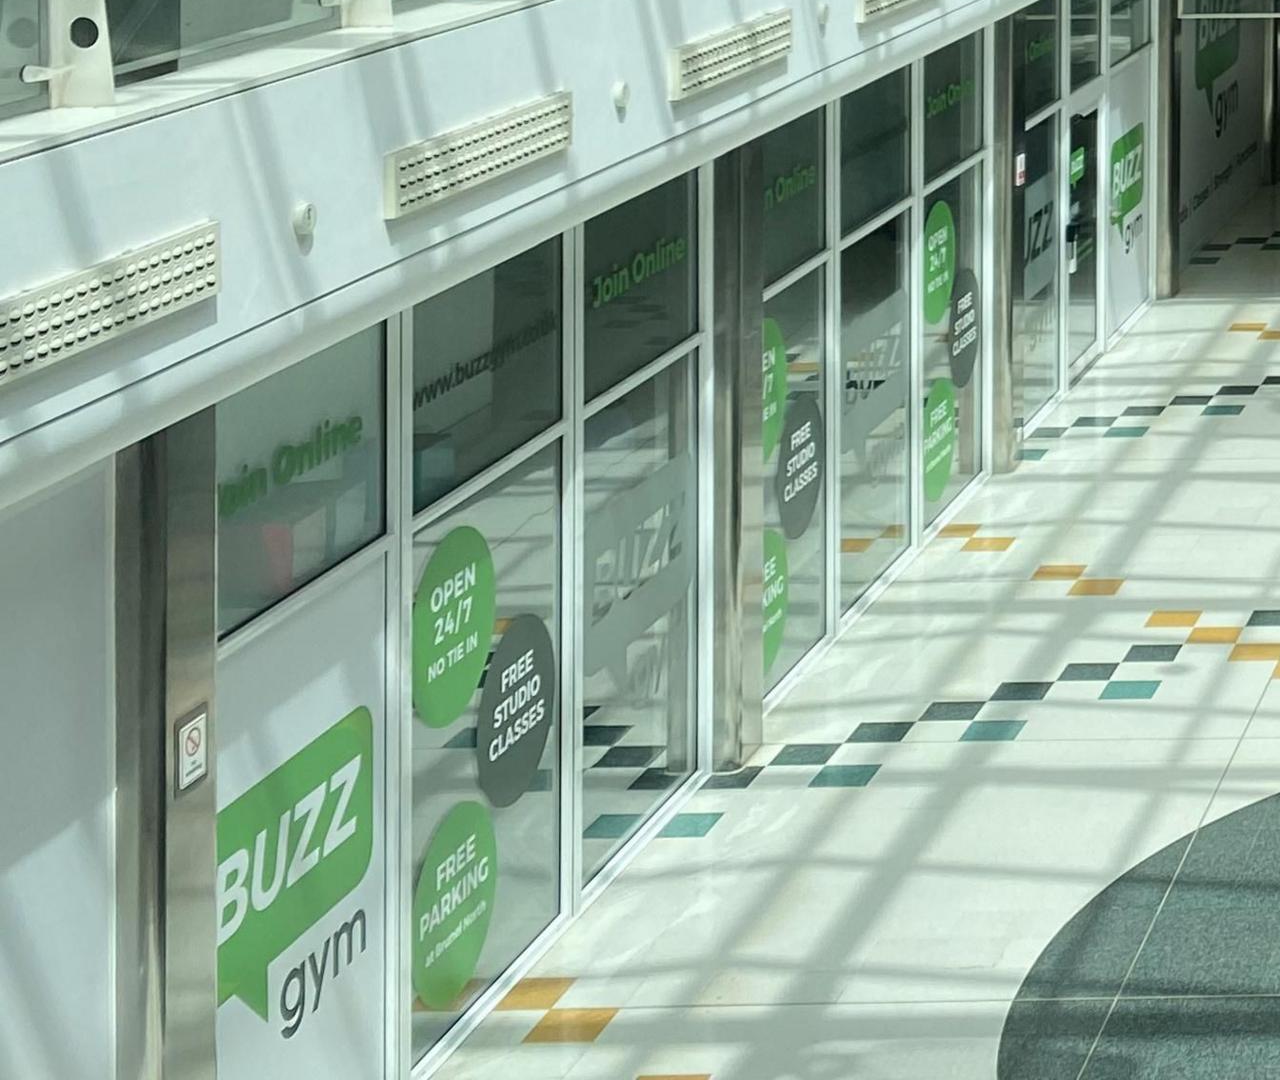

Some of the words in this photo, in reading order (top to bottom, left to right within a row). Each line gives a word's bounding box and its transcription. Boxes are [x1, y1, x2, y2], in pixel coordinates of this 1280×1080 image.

[1215, 80, 1239, 138] gym
[775, 164, 816, 203] Online
[1112, 143, 1142, 200] BUZZ
[1124, 213, 1144, 255] gym
[592, 263, 630, 309] Join
[632, 237, 687, 283] Online
[954, 309, 975, 336] STUDIO
[957, 291, 973, 315] FREE
[762, 347, 776, 373] EN
[952, 326, 977, 357] CLASSES
[791, 422, 811, 452] FREE
[930, 399, 948, 428] FREE
[272, 415, 363, 487] Online
[786, 441, 815, 478] STUDIO
[784, 461, 818, 503] CLASSES
[430, 562, 476, 613] OPEN
[763, 555, 777, 583] EE
[763, 575, 784, 608] KING
[434, 595, 473, 645] 24/7
[428, 656, 445, 684] NO
[447, 640, 464, 668] TIE
[466, 631, 478, 655] IN
[501, 648, 534, 693] FREE
[493, 674, 541, 729] STUDIO
[489, 698, 545, 762] CLASSES
[217, 753, 362, 948] BUZZ
[436, 833, 477, 892] FREE
[419, 856, 489, 942] PARKING
[279, 908, 367, 1040] gym
